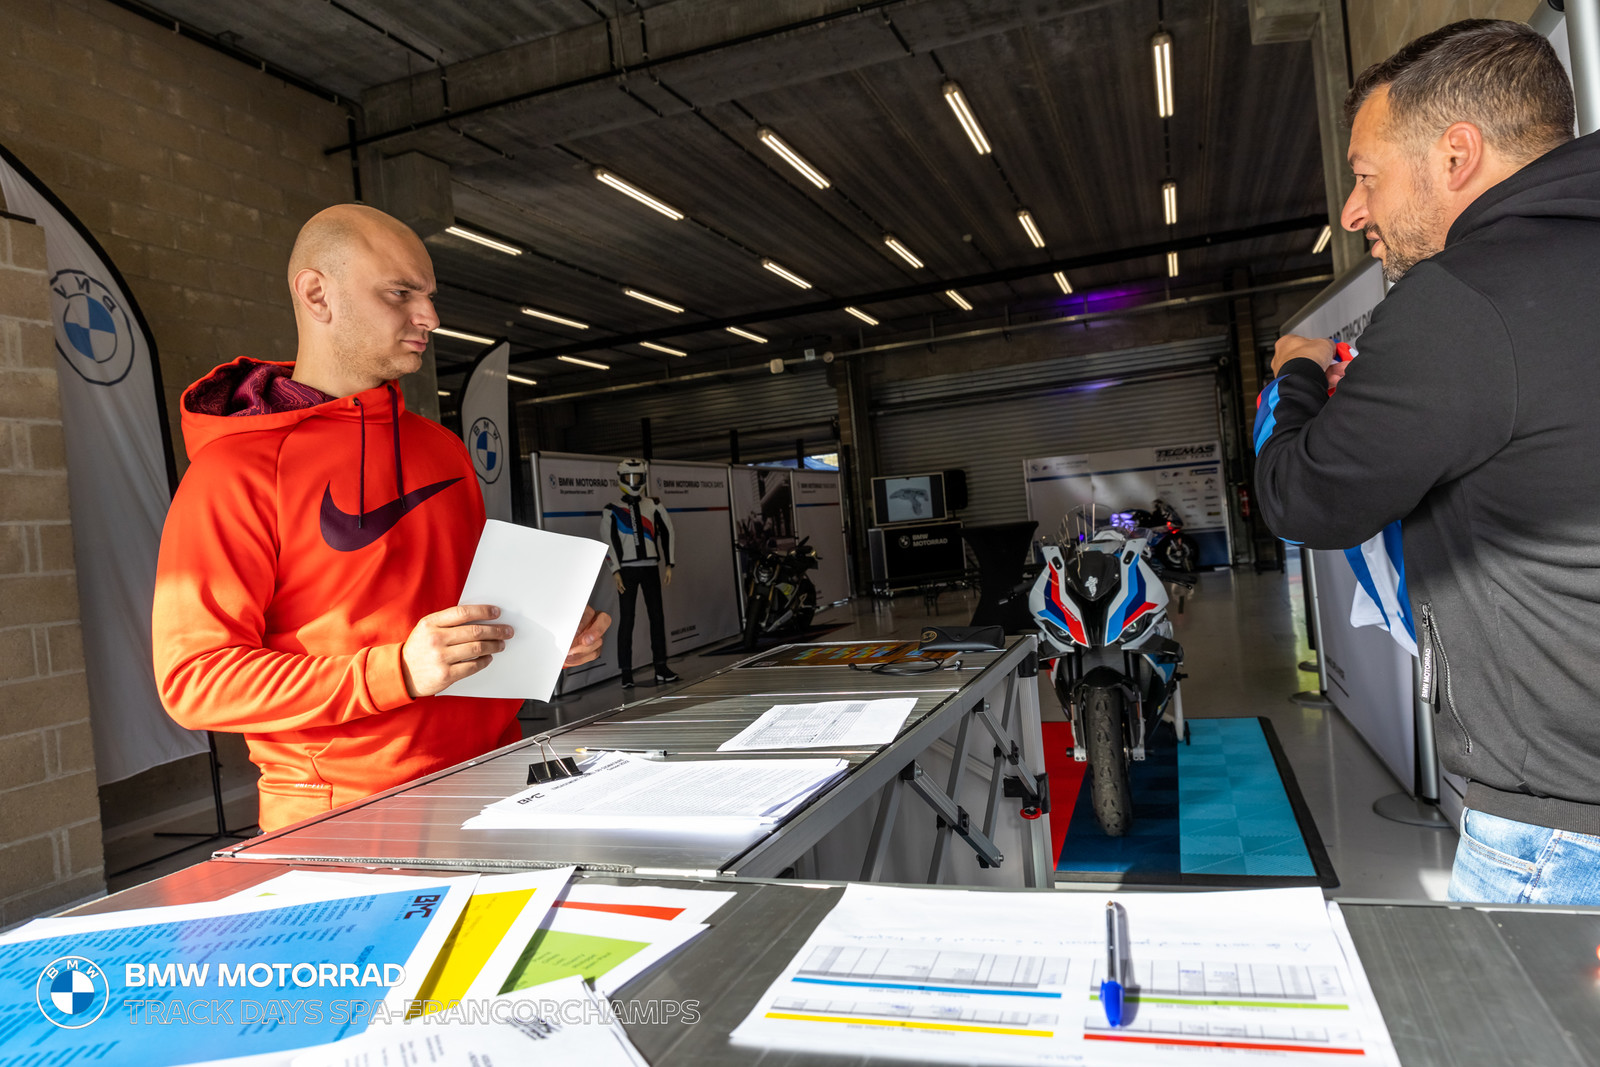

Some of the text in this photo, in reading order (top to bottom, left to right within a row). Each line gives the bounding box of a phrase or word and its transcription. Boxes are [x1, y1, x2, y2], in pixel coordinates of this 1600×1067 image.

[1155, 443, 1216, 457] TECMAS
[558, 477, 574, 487] BMW
[575, 478, 609, 488] MOTORRAD
[912, 533, 929, 541] BMW
[912, 538, 949, 547] MOTORRAD
[1421, 648, 1431, 699] BMW MOTORRAD
